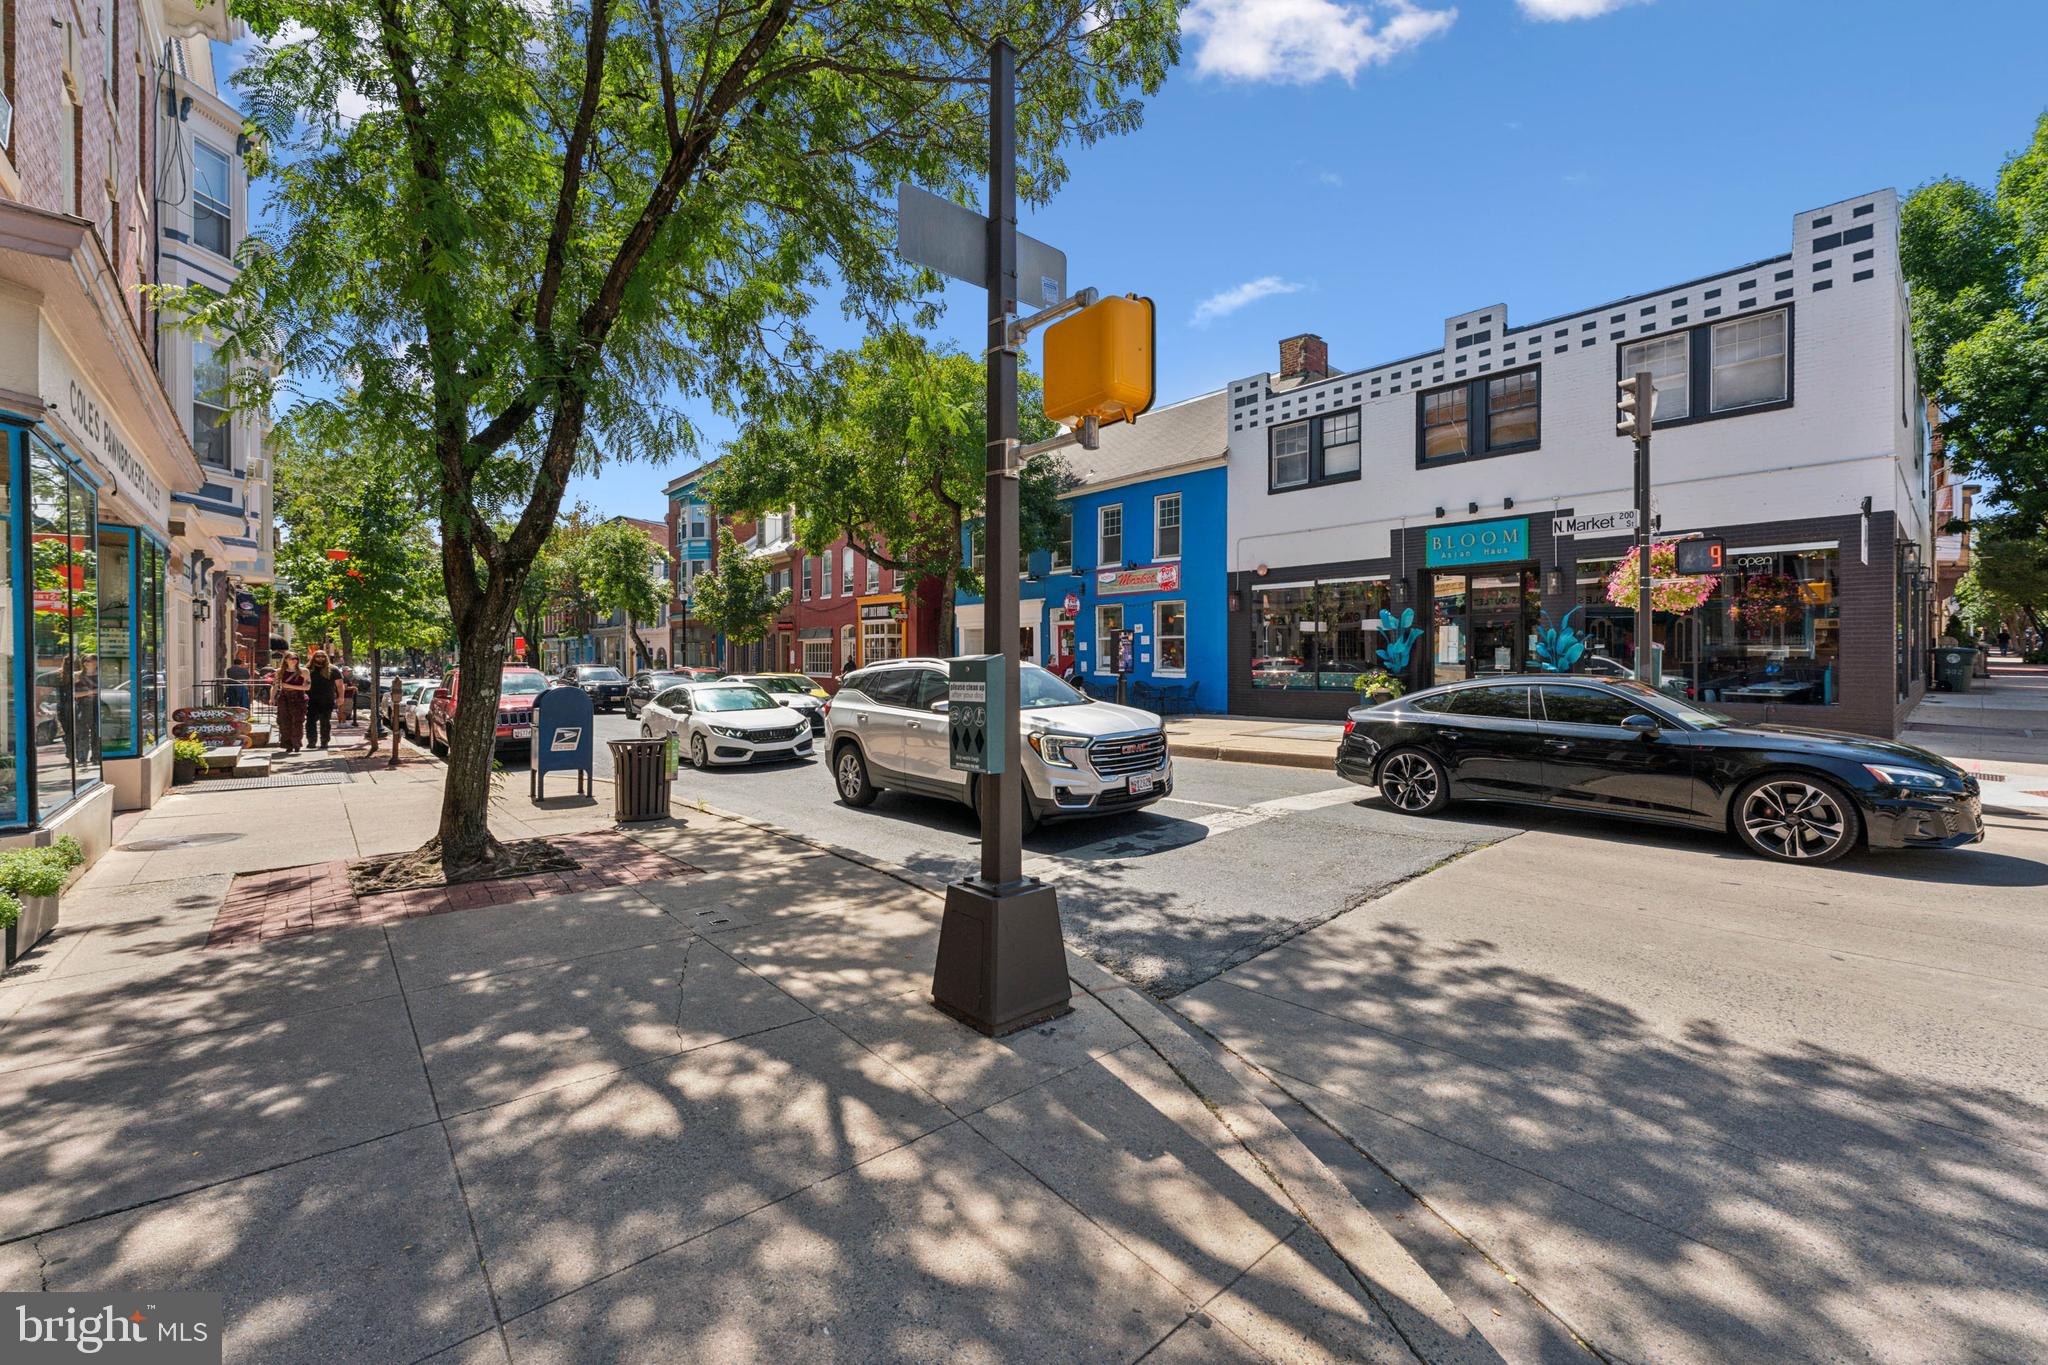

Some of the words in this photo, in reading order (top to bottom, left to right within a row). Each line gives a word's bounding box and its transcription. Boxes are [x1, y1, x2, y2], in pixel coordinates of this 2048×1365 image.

[103, 420, 145, 495] PAWNBROKERS
[1619, 511, 1634, 520] 200
[1553, 520, 1565, 534] N.
[1566, 516, 1615, 533] Market
[1432, 528, 1518, 550] BLOOM
[1441, 551, 1471, 559] Asian
[1483, 547, 1508, 555] Haus
[1710, 544, 1722, 569] 9
[1737, 556, 1772, 568] open
[1117, 572, 1156, 585] Market
[951, 683, 965, 691] please
[1121, 743, 1149, 754] GMC
